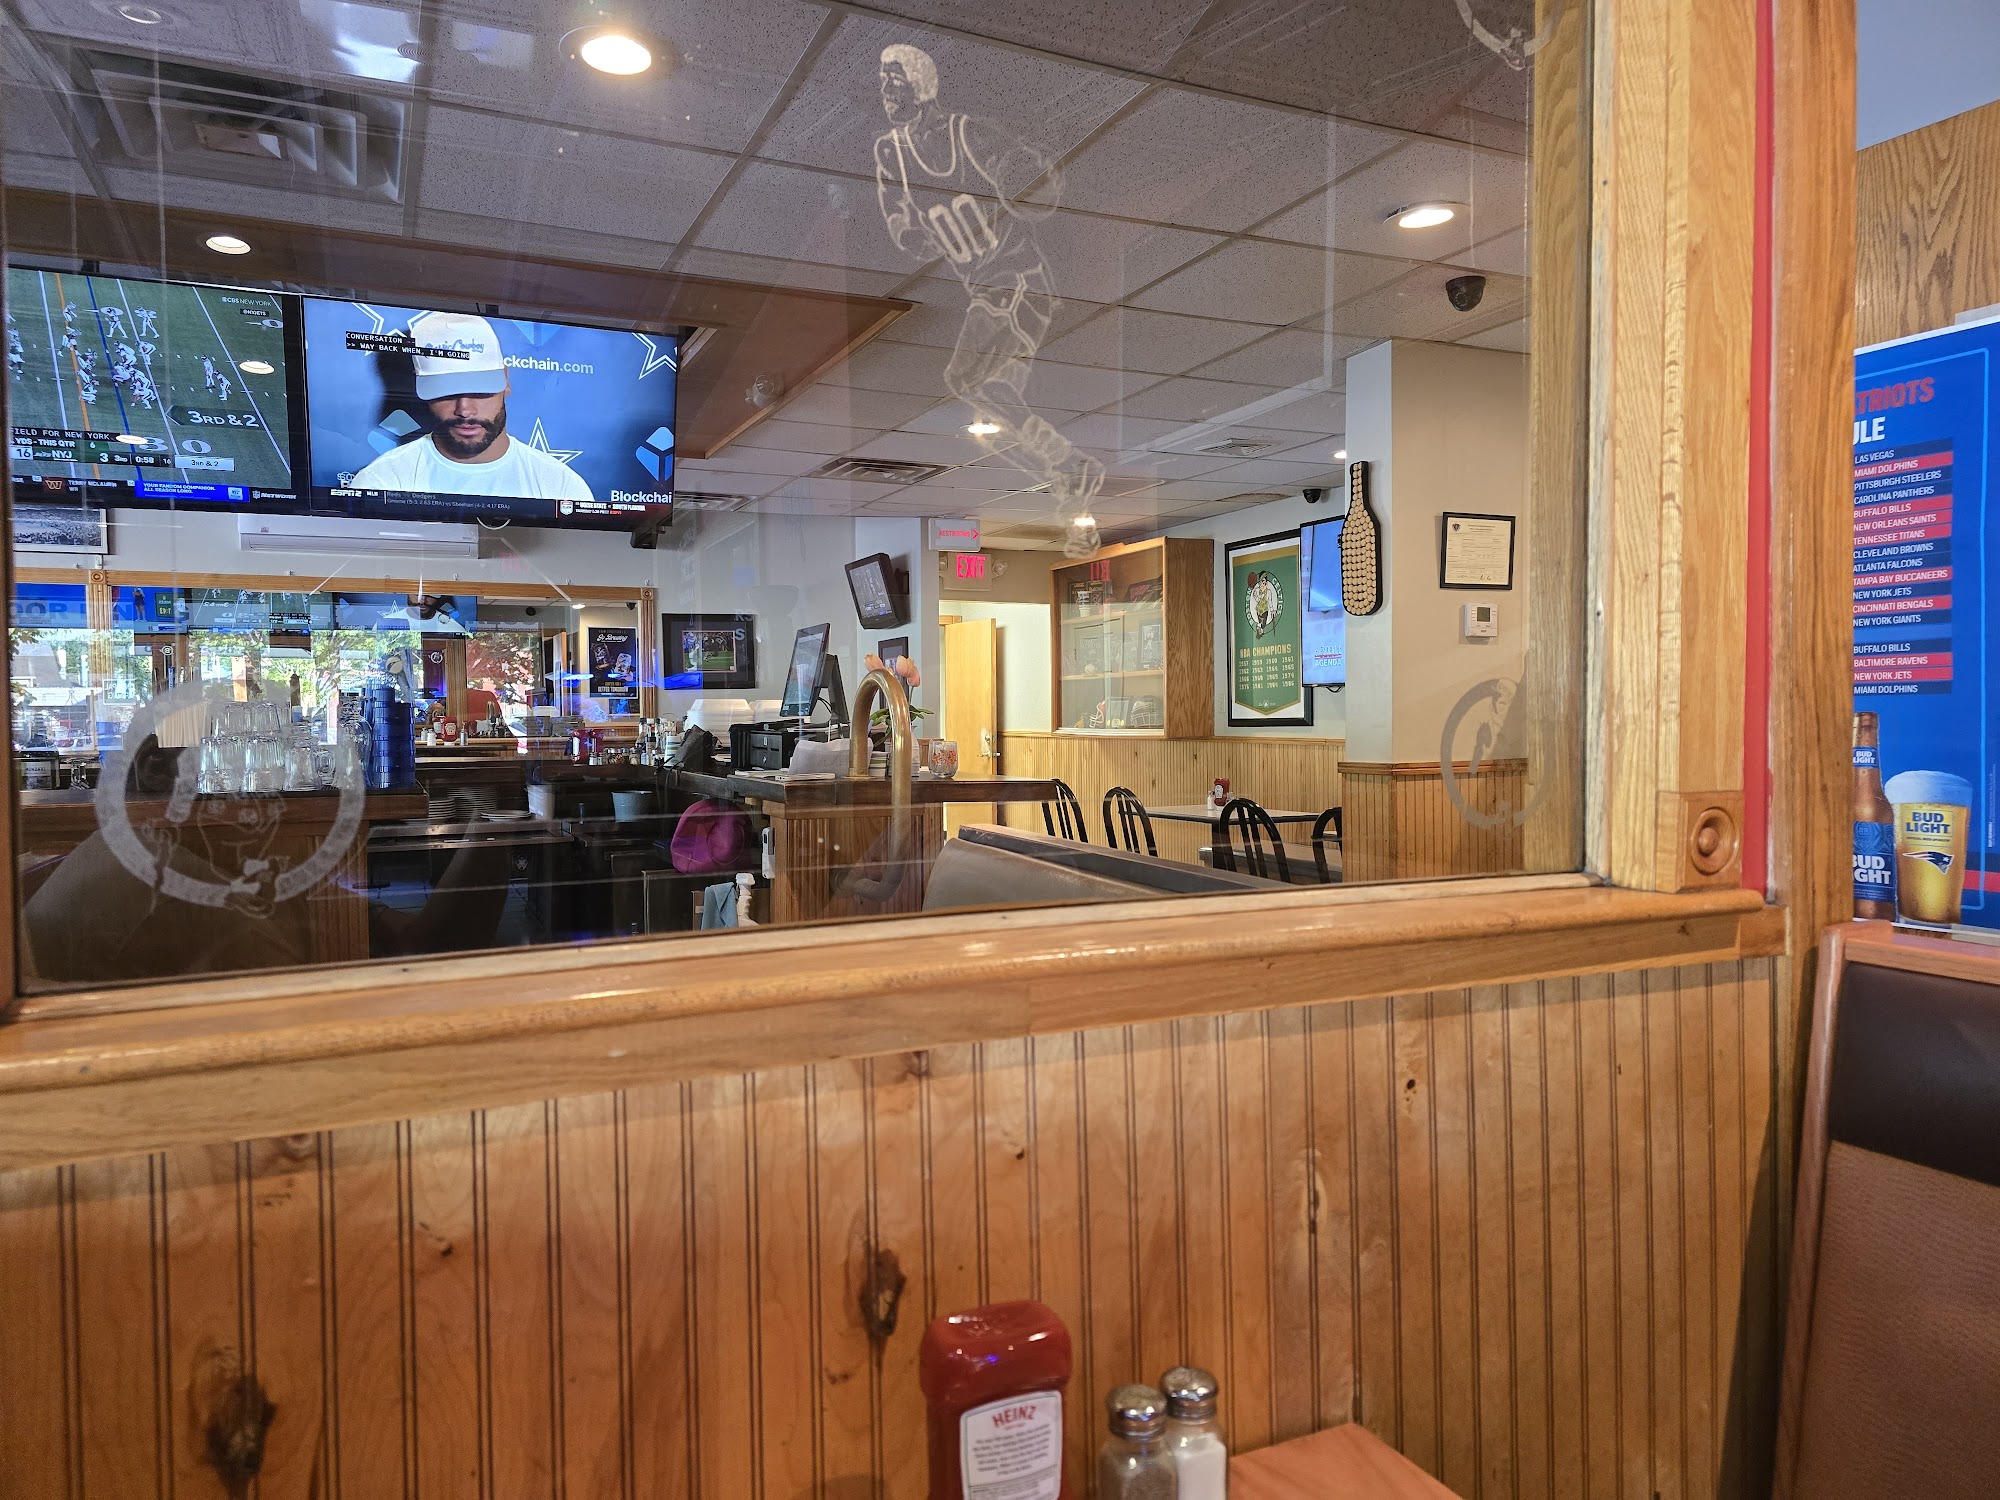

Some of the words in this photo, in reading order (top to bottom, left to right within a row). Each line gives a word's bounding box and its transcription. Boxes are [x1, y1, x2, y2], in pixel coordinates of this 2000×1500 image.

[346, 332, 403, 344] CONVERSATION
[447, 351, 470, 359] GOING
[187, 410, 226, 425] 3RD
[227, 414, 243, 426] &
[242, 414, 260, 427] 2
[42, 429, 60, 437] FOR
[37, 439, 57, 447] THIS
[16, 448, 31, 458] 16
[51, 450, 73, 459] NYJ
[99, 452, 109, 463] 3
[1855, 454, 1870, 464] LAS
[1870, 450, 1895, 462] VEGAS
[1854, 466, 1877, 478] MIAMI
[1878, 460, 1919, 474] DOLPHINS
[1854, 476, 1901, 491] PITTSBURGH
[1901, 470, 1942, 484] STEELERS
[411, 492, 437, 500] Dodgers
[610, 489, 672, 503] Blockchai
[1853, 490, 1892, 505] CAROLINA
[1892, 486, 1935, 500] PANTHERS
[1853, 507, 1888, 518] BUFFALO
[1888, 503, 1912, 515] BILLS
[1853, 521, 1871, 532] NEW
[1872, 517, 1908, 531] ORLEANS
[1909, 514, 1937, 526] SAINTS
[939, 530, 971, 538] RESTROOMS
[1853, 533, 1898, 546] TENNESSEE
[1899, 529, 1926, 541] TITANS
[1853, 547, 1899, 559] CLEVELAND
[1899, 543, 1934, 555] BROWNS
[956, 554, 986, 579] EXIT
[1853, 561, 1886, 573] ATLANTA
[1887, 558, 1923, 570] FALCONS
[1853, 575, 1878, 586] TAMPA
[1878, 573, 1894, 584] BAY
[1894, 569, 1948, 583] BUCCANEERS
[1271, 577, 1284, 616] CELTICS
[1853, 589, 1870, 600] NEW
[1871, 588, 1892, 598] YORK
[1893, 587, 1912, 597] JETS
[1853, 602, 1896, 614] CINCINNATI
[1896, 599, 1934, 611] BENGALS
[1853, 617, 1870, 627] NEW
[1871, 616, 1892, 626] YORK
[1892, 614, 1922, 625] GIANTS
[1240, 648, 1251, 659] NBA
[1252, 643, 1292, 657] CHAMPIONS
[1853, 644, 1888, 654] BUFFALO
[1888, 643, 1911, 652] BILLS
[1314, 658, 1343, 667] AGENDA
[1854, 657, 1897, 668] BALTIMORE
[1897, 656, 1928, 666] RAVENS
[1854, 672, 1872, 681] NEW
[1872, 672, 1893, 681] YORK
[1893, 671, 1913, 680] JETS
[1854, 685, 1878, 695] MIAMI
[1878, 684, 1918, 694] DOLPHINS
[1855, 750, 1873, 758] BUD
[1912, 811, 1945, 824] BUD
[1906, 822, 1951, 835] LIGHT
[992, 1405, 1037, 1428] HEINZ
